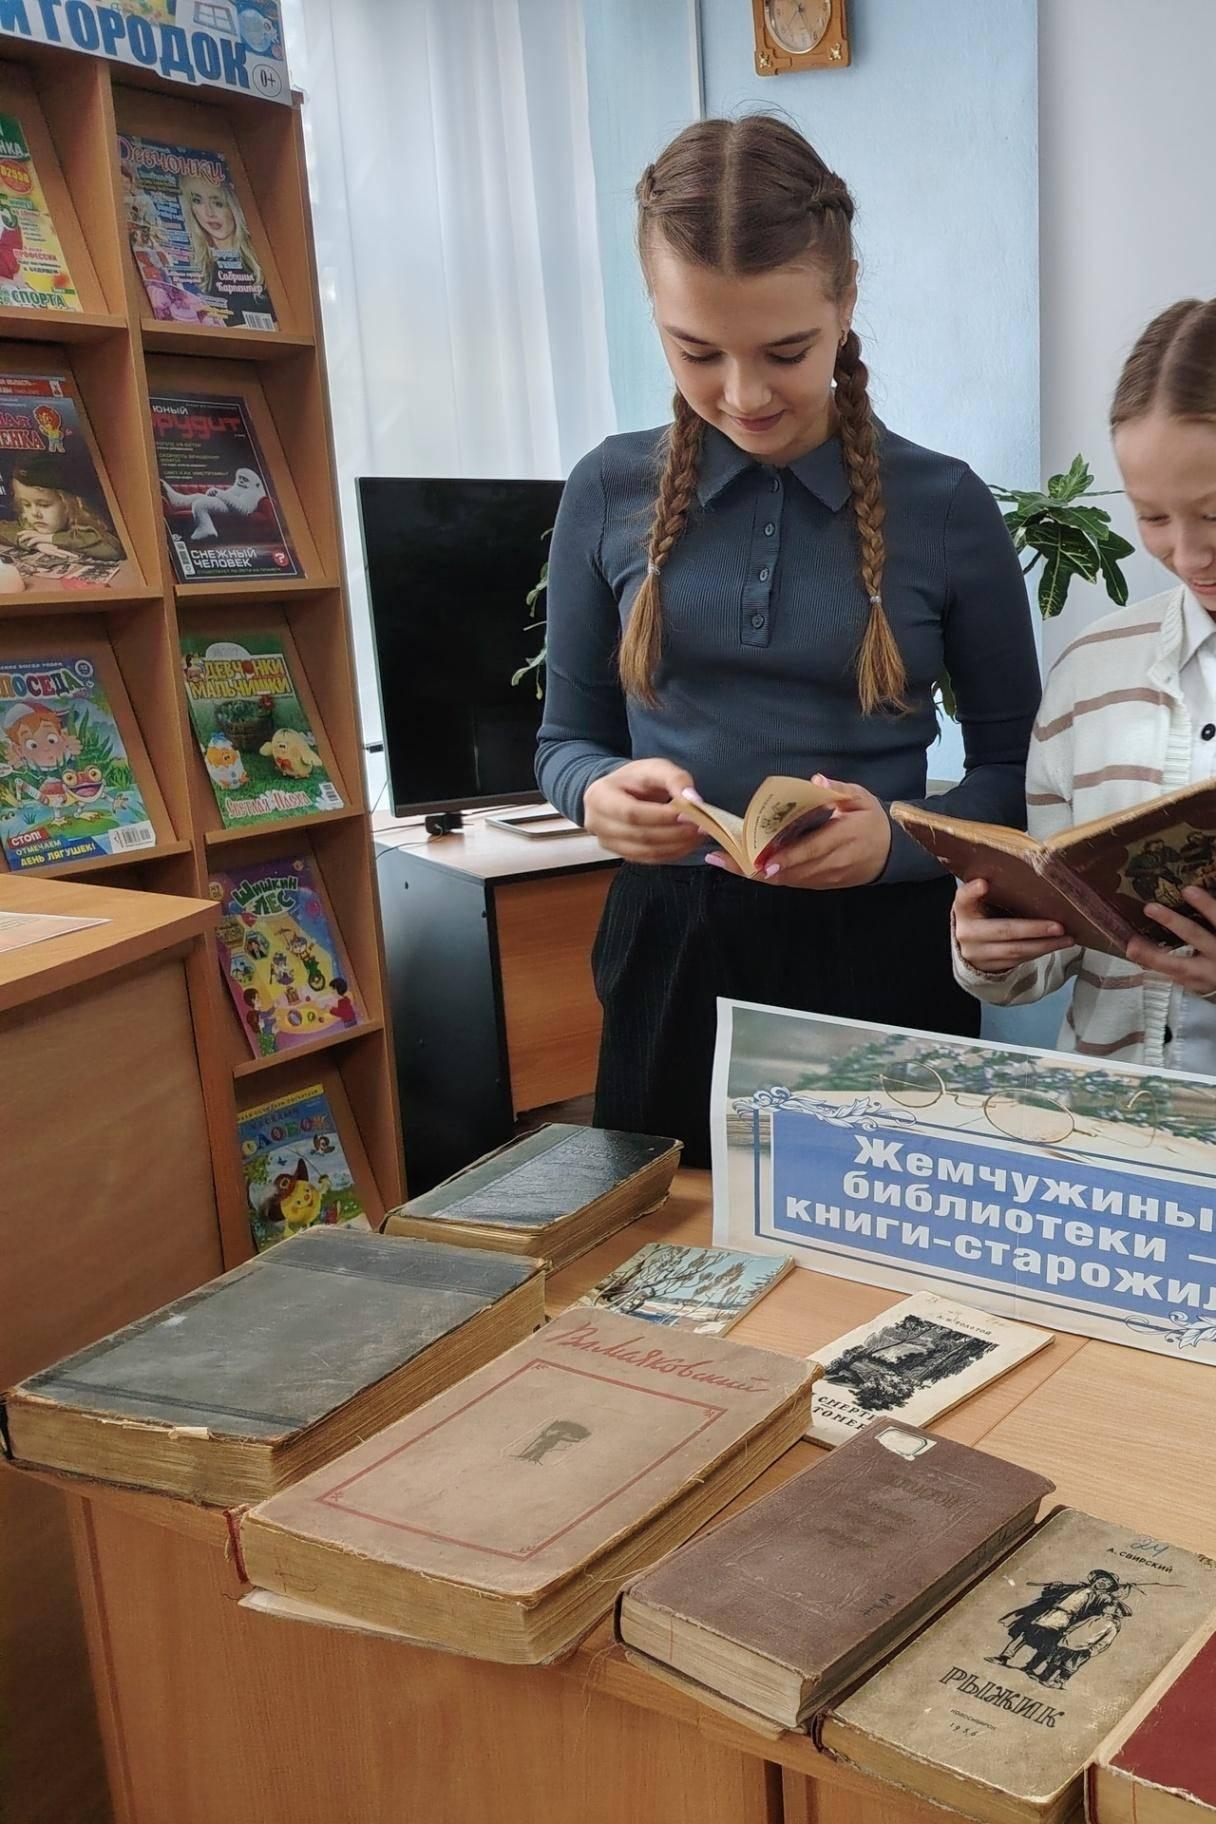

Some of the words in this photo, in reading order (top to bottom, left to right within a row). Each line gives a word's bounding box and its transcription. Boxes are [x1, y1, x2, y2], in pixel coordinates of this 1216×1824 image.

[38, 0, 250, 90] ГОРОДОК
[259, 70, 277, 88] 0+
[12, 287, 65, 308] СПОРТА
[152, 404, 189, 415] ЮНЫЙ
[190, 546, 257, 560] СНЕЖНЫЙ
[193, 558, 252, 569] ЧЕЛОВЕК
[189, 677, 293, 699] МАЛЬЧИШКИ
[11, 830, 42, 846] СТОП!
[15, 840, 62, 856] ОТМЕЧАЕМ
[20, 855, 46, 867] ДЕНЬ
[47, 842, 97, 861] ЛЯГУШЕК!
[852, 1134, 1214, 1234] Жемчужины
[842, 1169, 1167, 1264] библиотеки
[1106, 1547, 1117, 1555] А.
[1119, 1551, 1173, 1574] СВИРСКИЙ
[938, 1666, 1065, 1728] РЫЖИК
